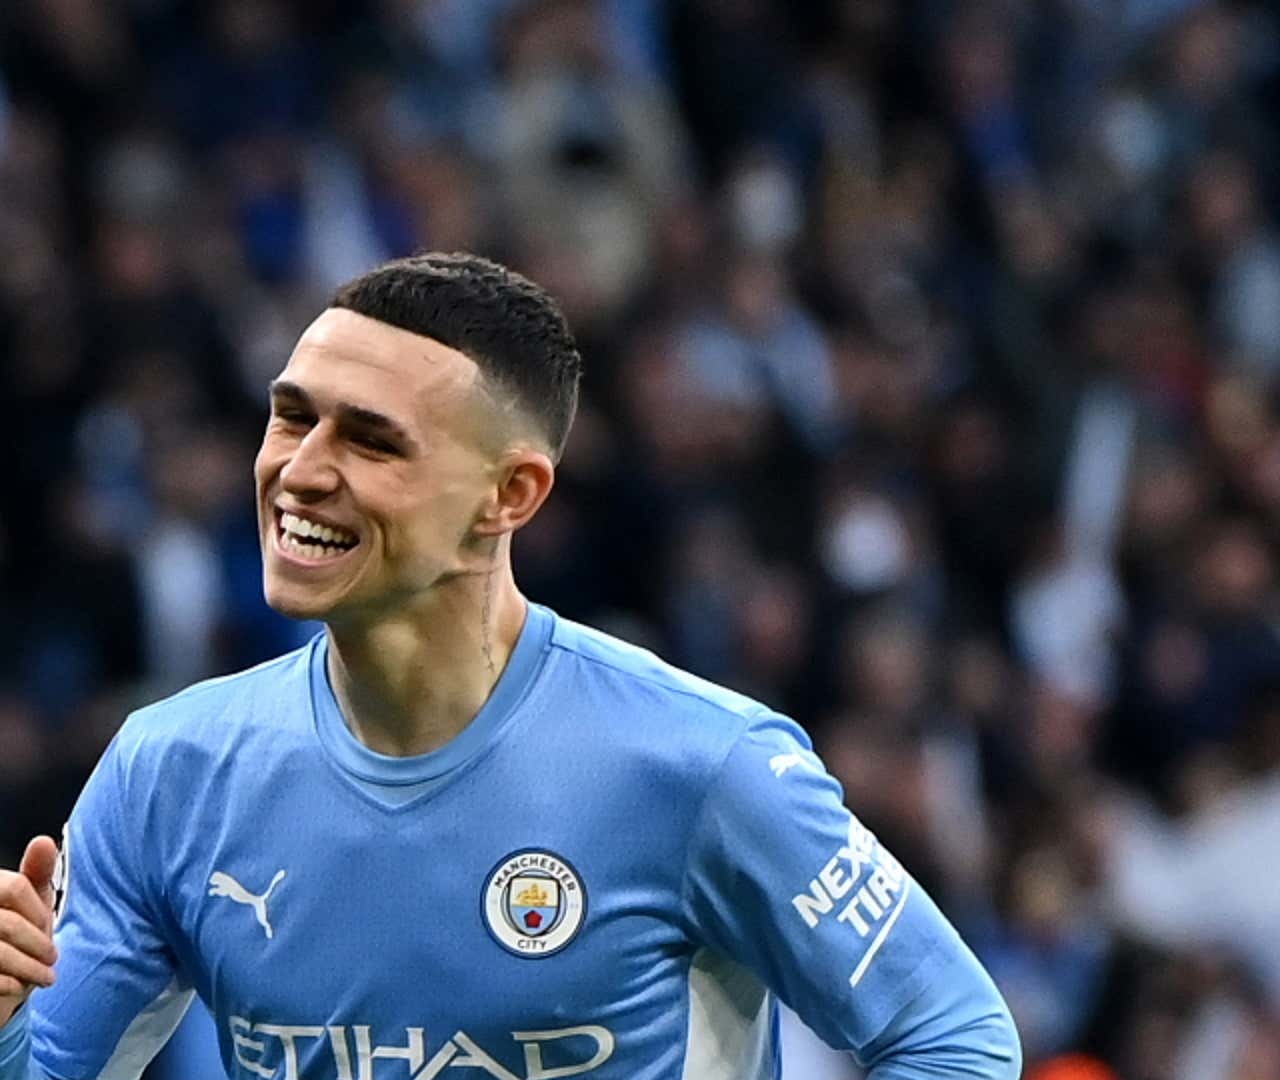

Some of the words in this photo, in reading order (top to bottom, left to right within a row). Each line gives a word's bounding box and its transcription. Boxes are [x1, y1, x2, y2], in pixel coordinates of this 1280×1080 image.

[494, 856, 577, 891] MANCHESTER
[791, 814, 878, 929] NEX
[837, 850, 908, 938] TIR
[517, 939, 547, 950] CITY
